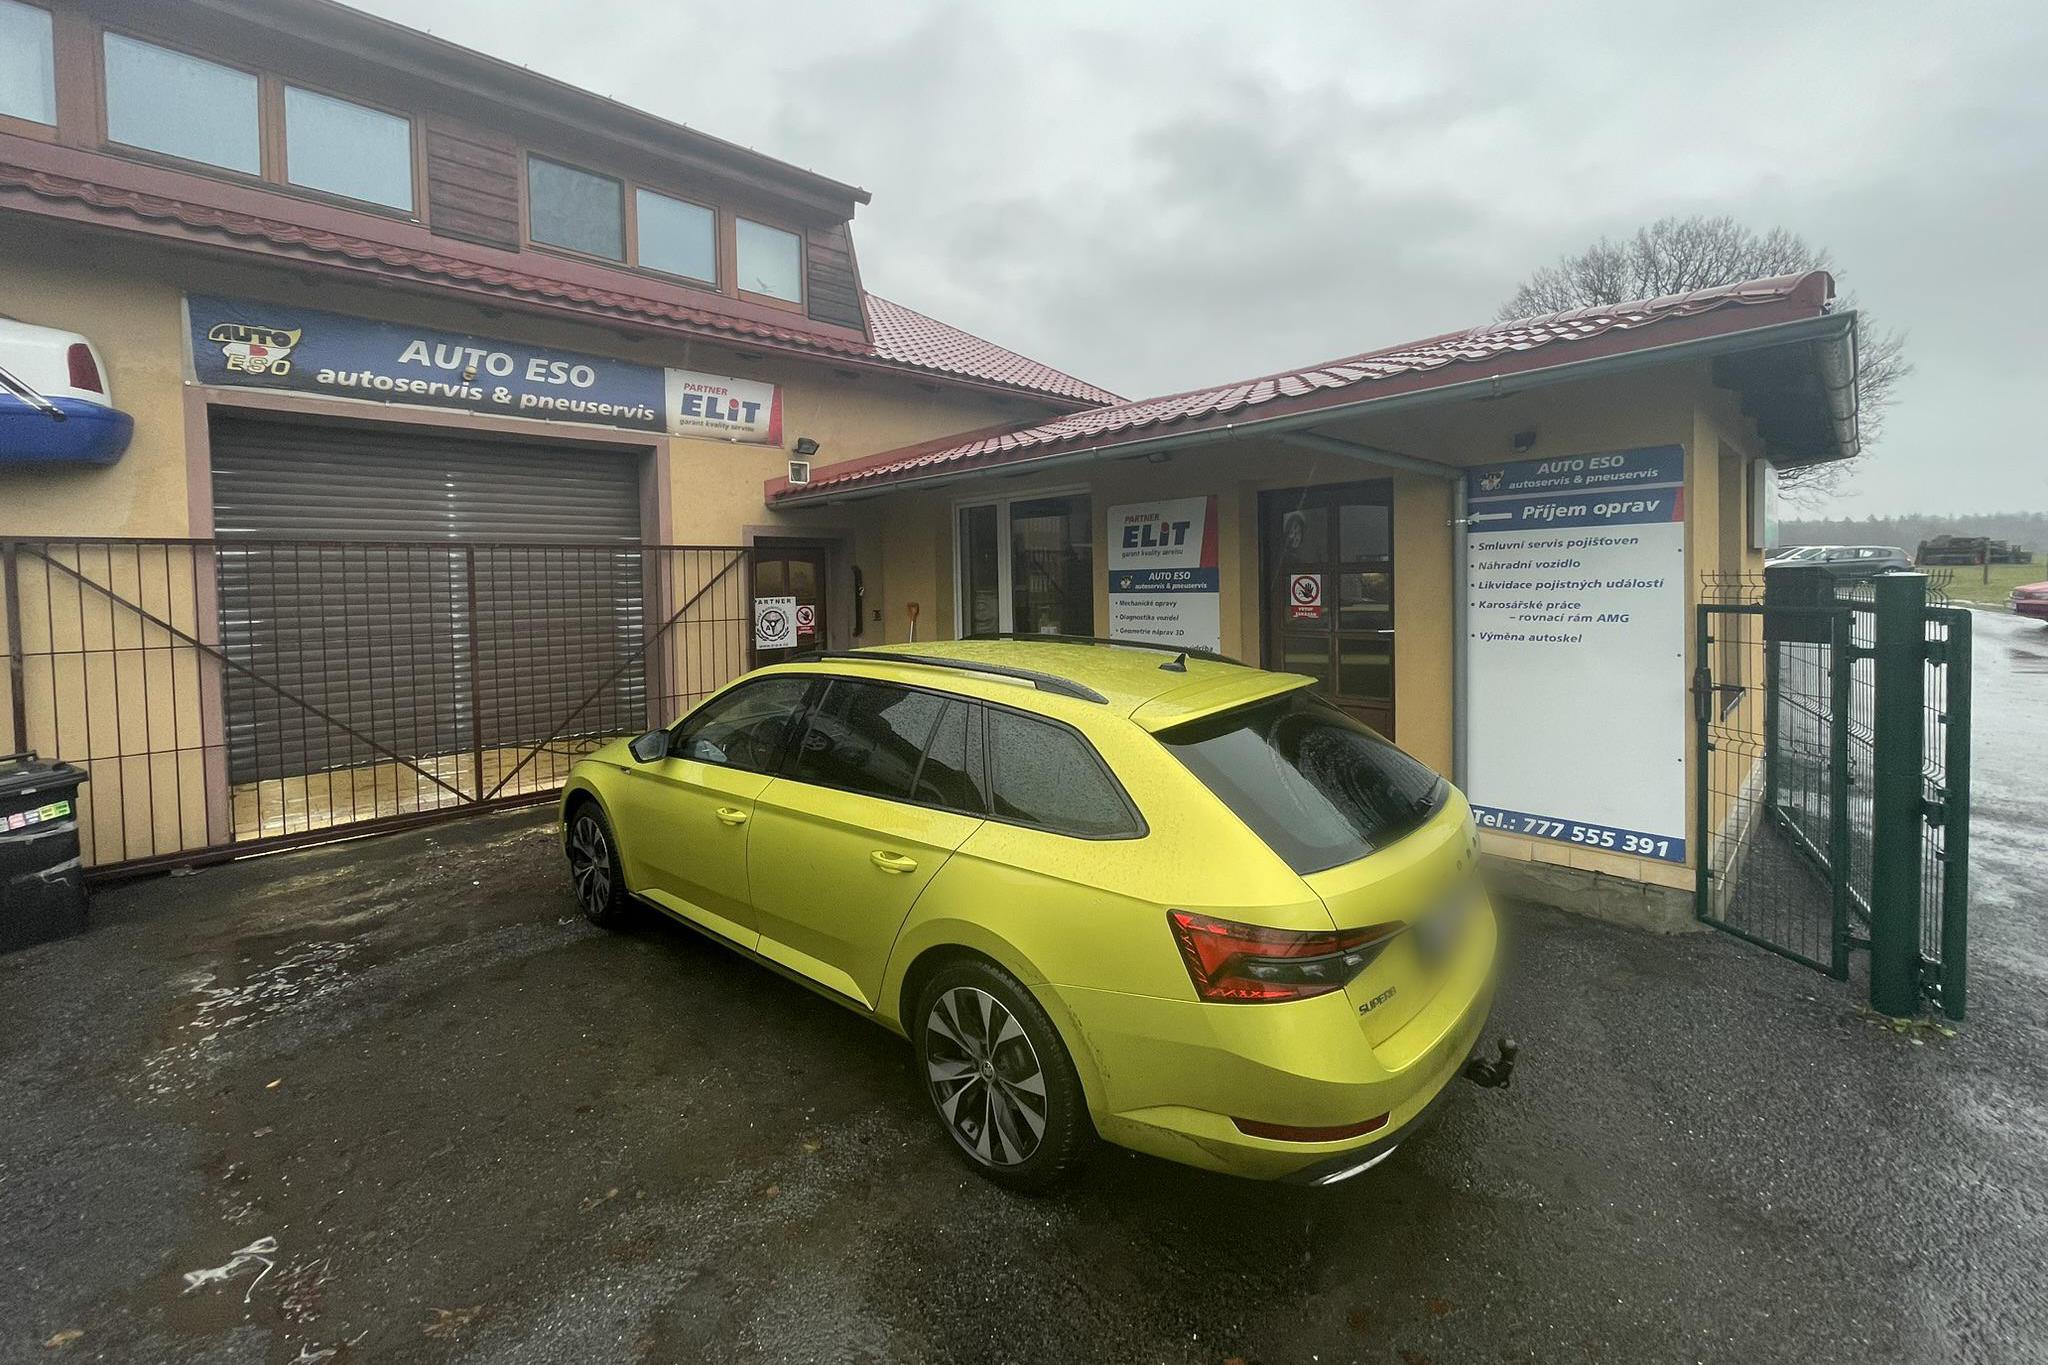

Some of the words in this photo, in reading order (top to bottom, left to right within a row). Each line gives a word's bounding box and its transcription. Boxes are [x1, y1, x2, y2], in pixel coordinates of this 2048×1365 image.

[227, 353, 291, 376] ESO
[398, 340, 514, 377] AUTO
[526, 358, 595, 388] ESO
[316, 368, 483, 400] autoservis
[491, 386, 512, 404] &
[520, 393, 654, 421] pneuservis
[684, 383, 728, 396] PARTNER
[1536, 461, 1584, 475] AUTO
[1589, 455, 1624, 470] ESO
[1509, 477, 1570, 490] autoservis
[1574, 475, 1583, 484] &
[1586, 468, 1659, 485] pneuservis
[1522, 504, 1586, 522] Příjem
[1593, 499, 1661, 518] oprav
[1125, 514, 1160, 524] PARTNER
[1478, 541, 1524, 551] Smluvní
[1527, 538, 1563, 549] servis
[1566, 536, 1639, 549] pojišťoven
[1478, 560, 1532, 570] Náhradní
[1535, 558, 1581, 569] vozidlo
[1148, 572, 1171, 580] AUTO
[1173, 571, 1191, 580] ESO
[1478, 581, 1532, 589] Likvidace
[1535, 579, 1602, 591] pojistných
[1478, 601, 1543, 610] Karosářské
[1546, 601, 1582, 611] práce
[1518, 613, 1564, 622] rovnací
[1567, 613, 1593, 622] rám
[1596, 614, 1630, 623] AMG
[1479, 632, 1525, 642] Výměna
[1528, 634, 1582, 644] autoskel
[1474, 809, 1516, 830] Tel.:
[1522, 817, 1565, 838] 777
[1570, 827, 1616, 847] 555
[1622, 835, 1669, 857] 391
